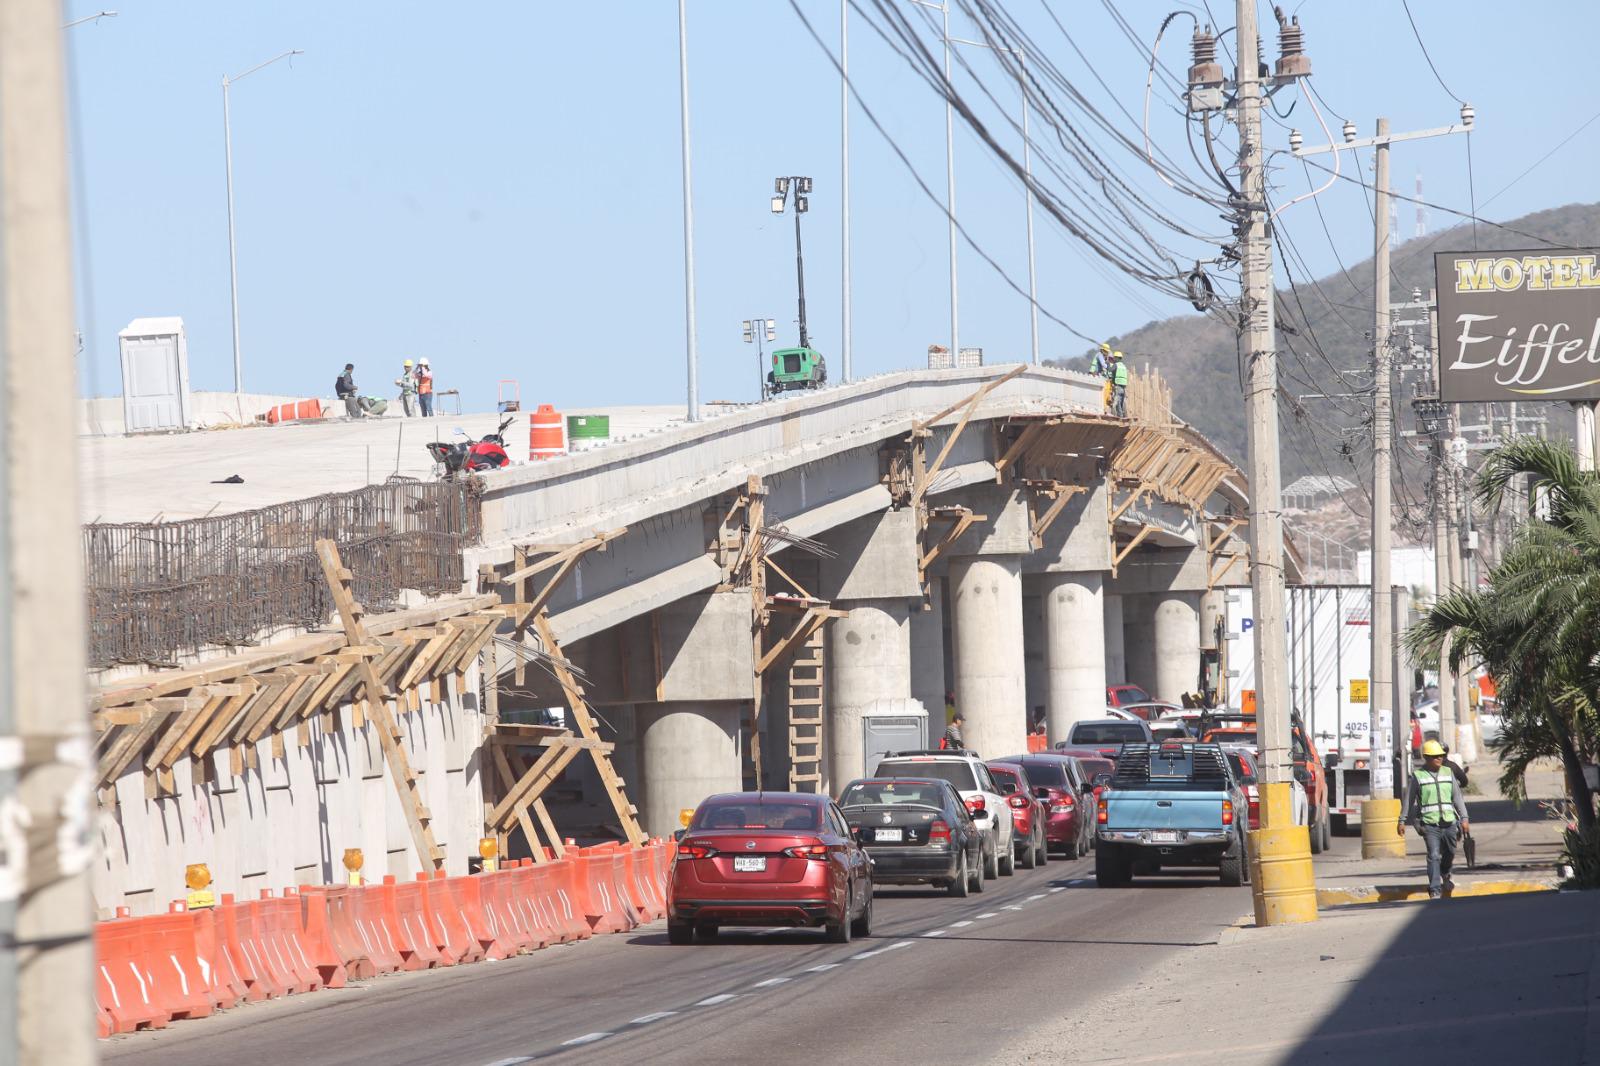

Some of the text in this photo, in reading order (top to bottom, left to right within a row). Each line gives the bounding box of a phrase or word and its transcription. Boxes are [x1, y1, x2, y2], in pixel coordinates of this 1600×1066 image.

[1455, 255, 1600, 293] MOTEL
[1449, 314, 1600, 385] Eiffel
[1345, 722, 1368, 731] 4025
